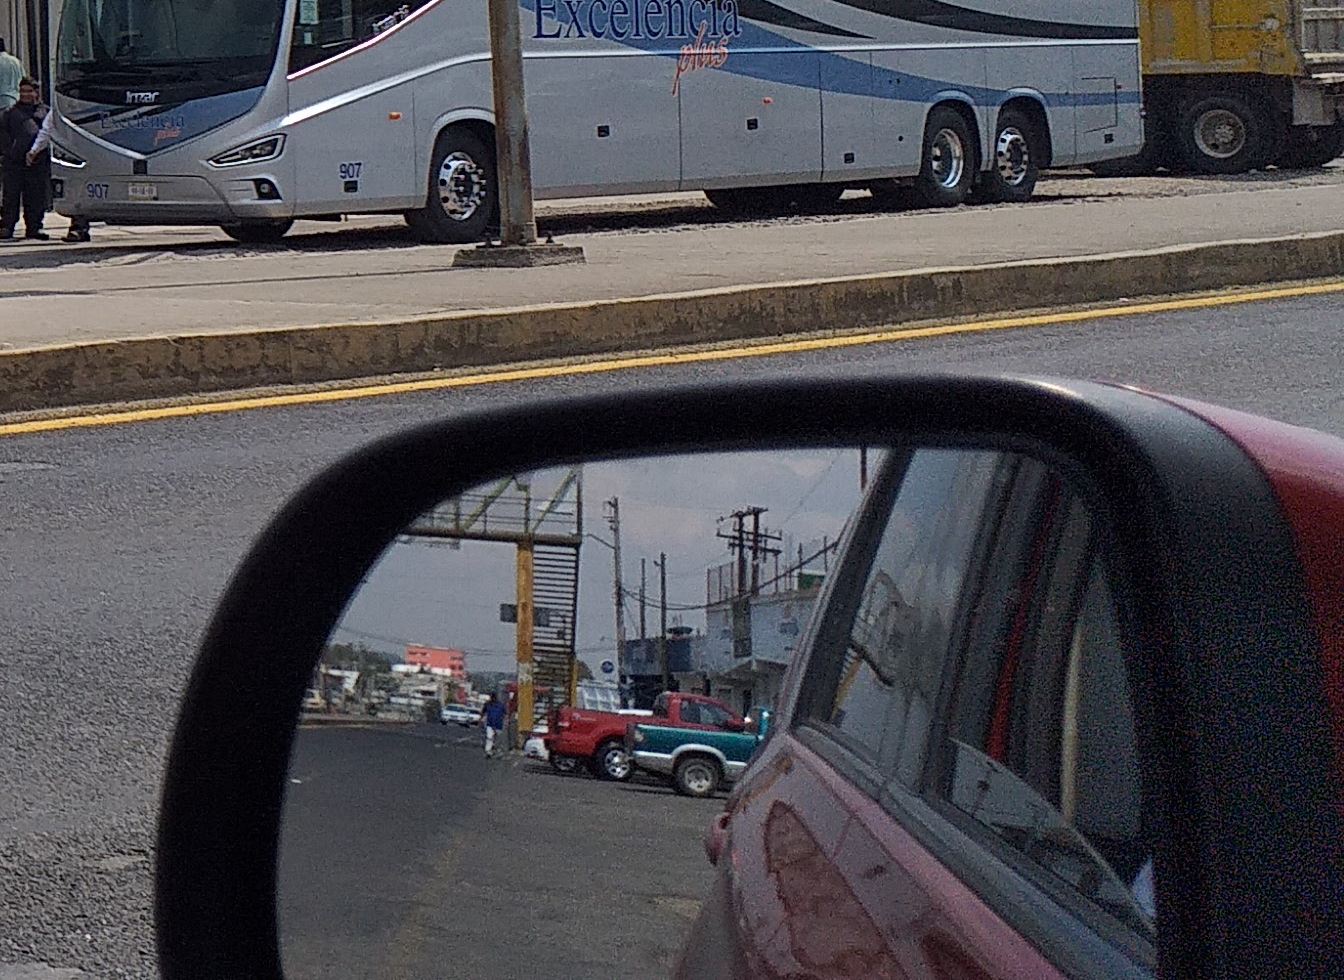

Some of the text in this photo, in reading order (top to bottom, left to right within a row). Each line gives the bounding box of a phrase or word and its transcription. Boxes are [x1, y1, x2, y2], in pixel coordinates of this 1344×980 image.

[672, 22, 730, 97] plus
[340, 162, 362, 180] 907
[86, 184, 110, 199] 907
